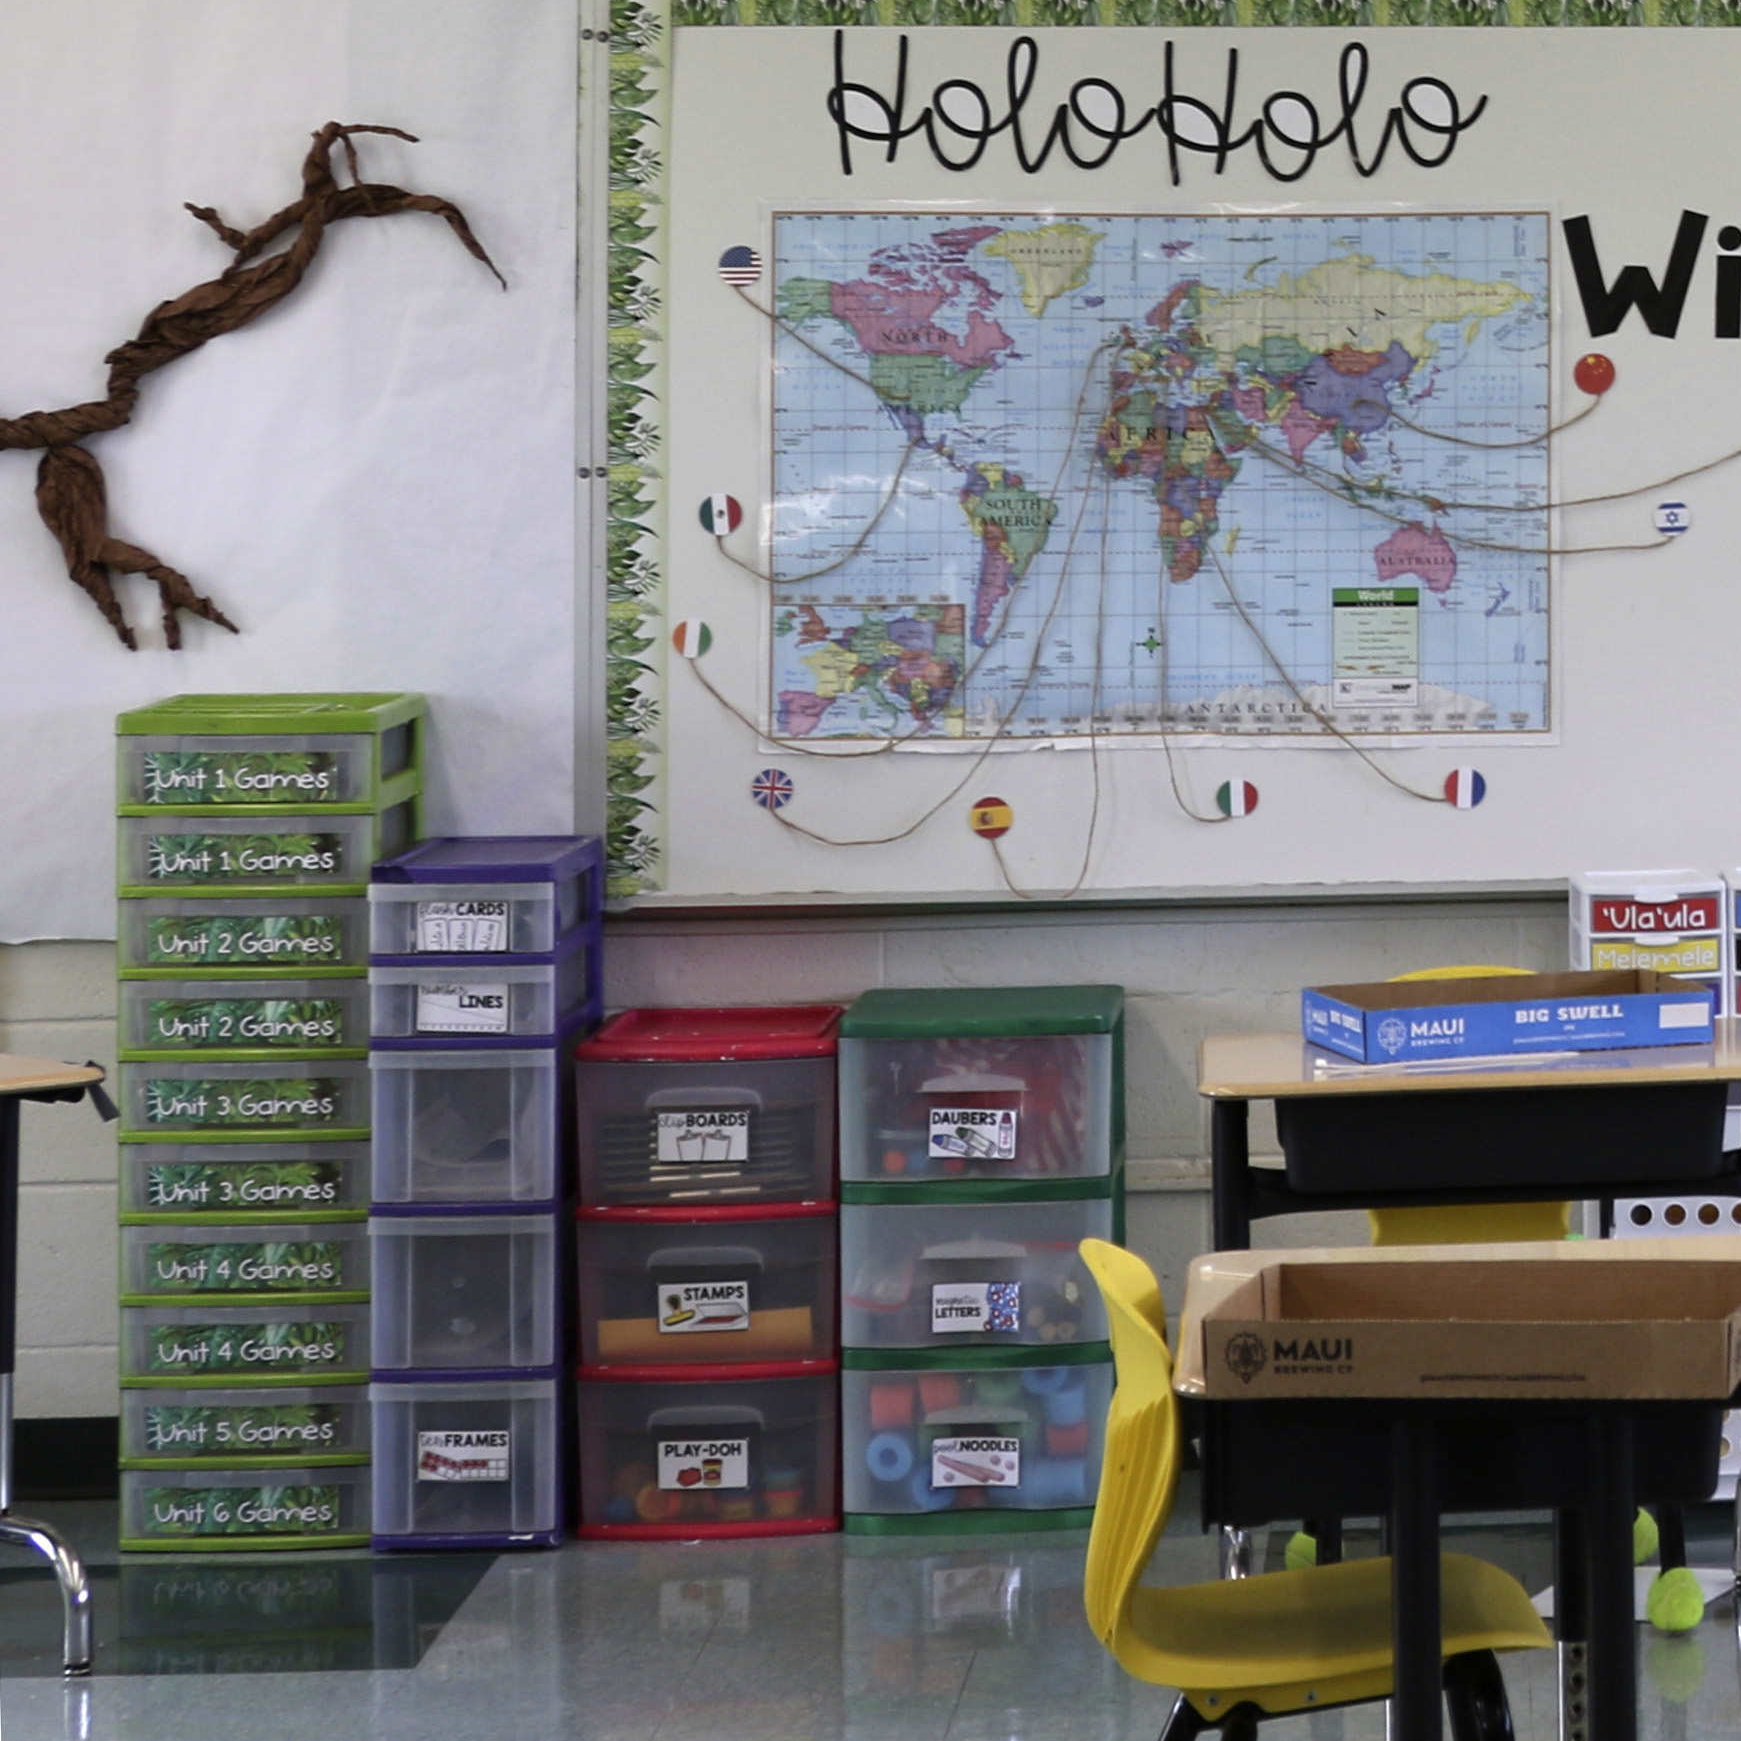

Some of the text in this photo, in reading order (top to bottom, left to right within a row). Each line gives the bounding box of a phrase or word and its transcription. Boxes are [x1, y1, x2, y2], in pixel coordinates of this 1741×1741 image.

[881, 331, 950, 343] NORTH
[986, 499, 1041, 512] SOUTH
[982, 515, 1052, 528] AMERICA
[1357, 590, 1394, 600] World
[1185, 703, 1326, 715] ANTARCTICA
[156, 767, 329, 789] Unit 1 Games
[161, 850, 334, 873] Unit 1 Games
[456, 903, 505, 916] CARDS
[158, 931, 334, 955] Unit 2 Games
[1597, 948, 1714, 970] Melemele
[459, 995, 503, 1008] LINES
[1515, 1004, 1624, 1024] BIG SWELL
[159, 1016, 334, 1038] Unit 2 Games
[1411, 1018, 1465, 1038] MAUI
[156, 1094, 333, 1116] Unit 3 Games
[932, 1111, 996, 1125] DAUBERS
[159, 1180, 335, 1203] Unit 3 Games
[157, 1258, 333, 1280] Unit 4 Games
[684, 1285, 744, 1301] STAMPS
[935, 1306, 980, 1318] LETTERS
[158, 1340, 334, 1363] Unit 4 Games
[1273, 1339, 1352, 1361] MAUI
[1274, 1364, 1333, 1374] BREWING
[157, 1421, 333, 1443] Unit 5 Games
[445, 1434, 507, 1447] FRAMES
[665, 1443, 741, 1457] PLAY-DOH
[960, 1440, 1017, 1452] NOODLES
[154, 1502, 332, 1523] Unit 6 Games
